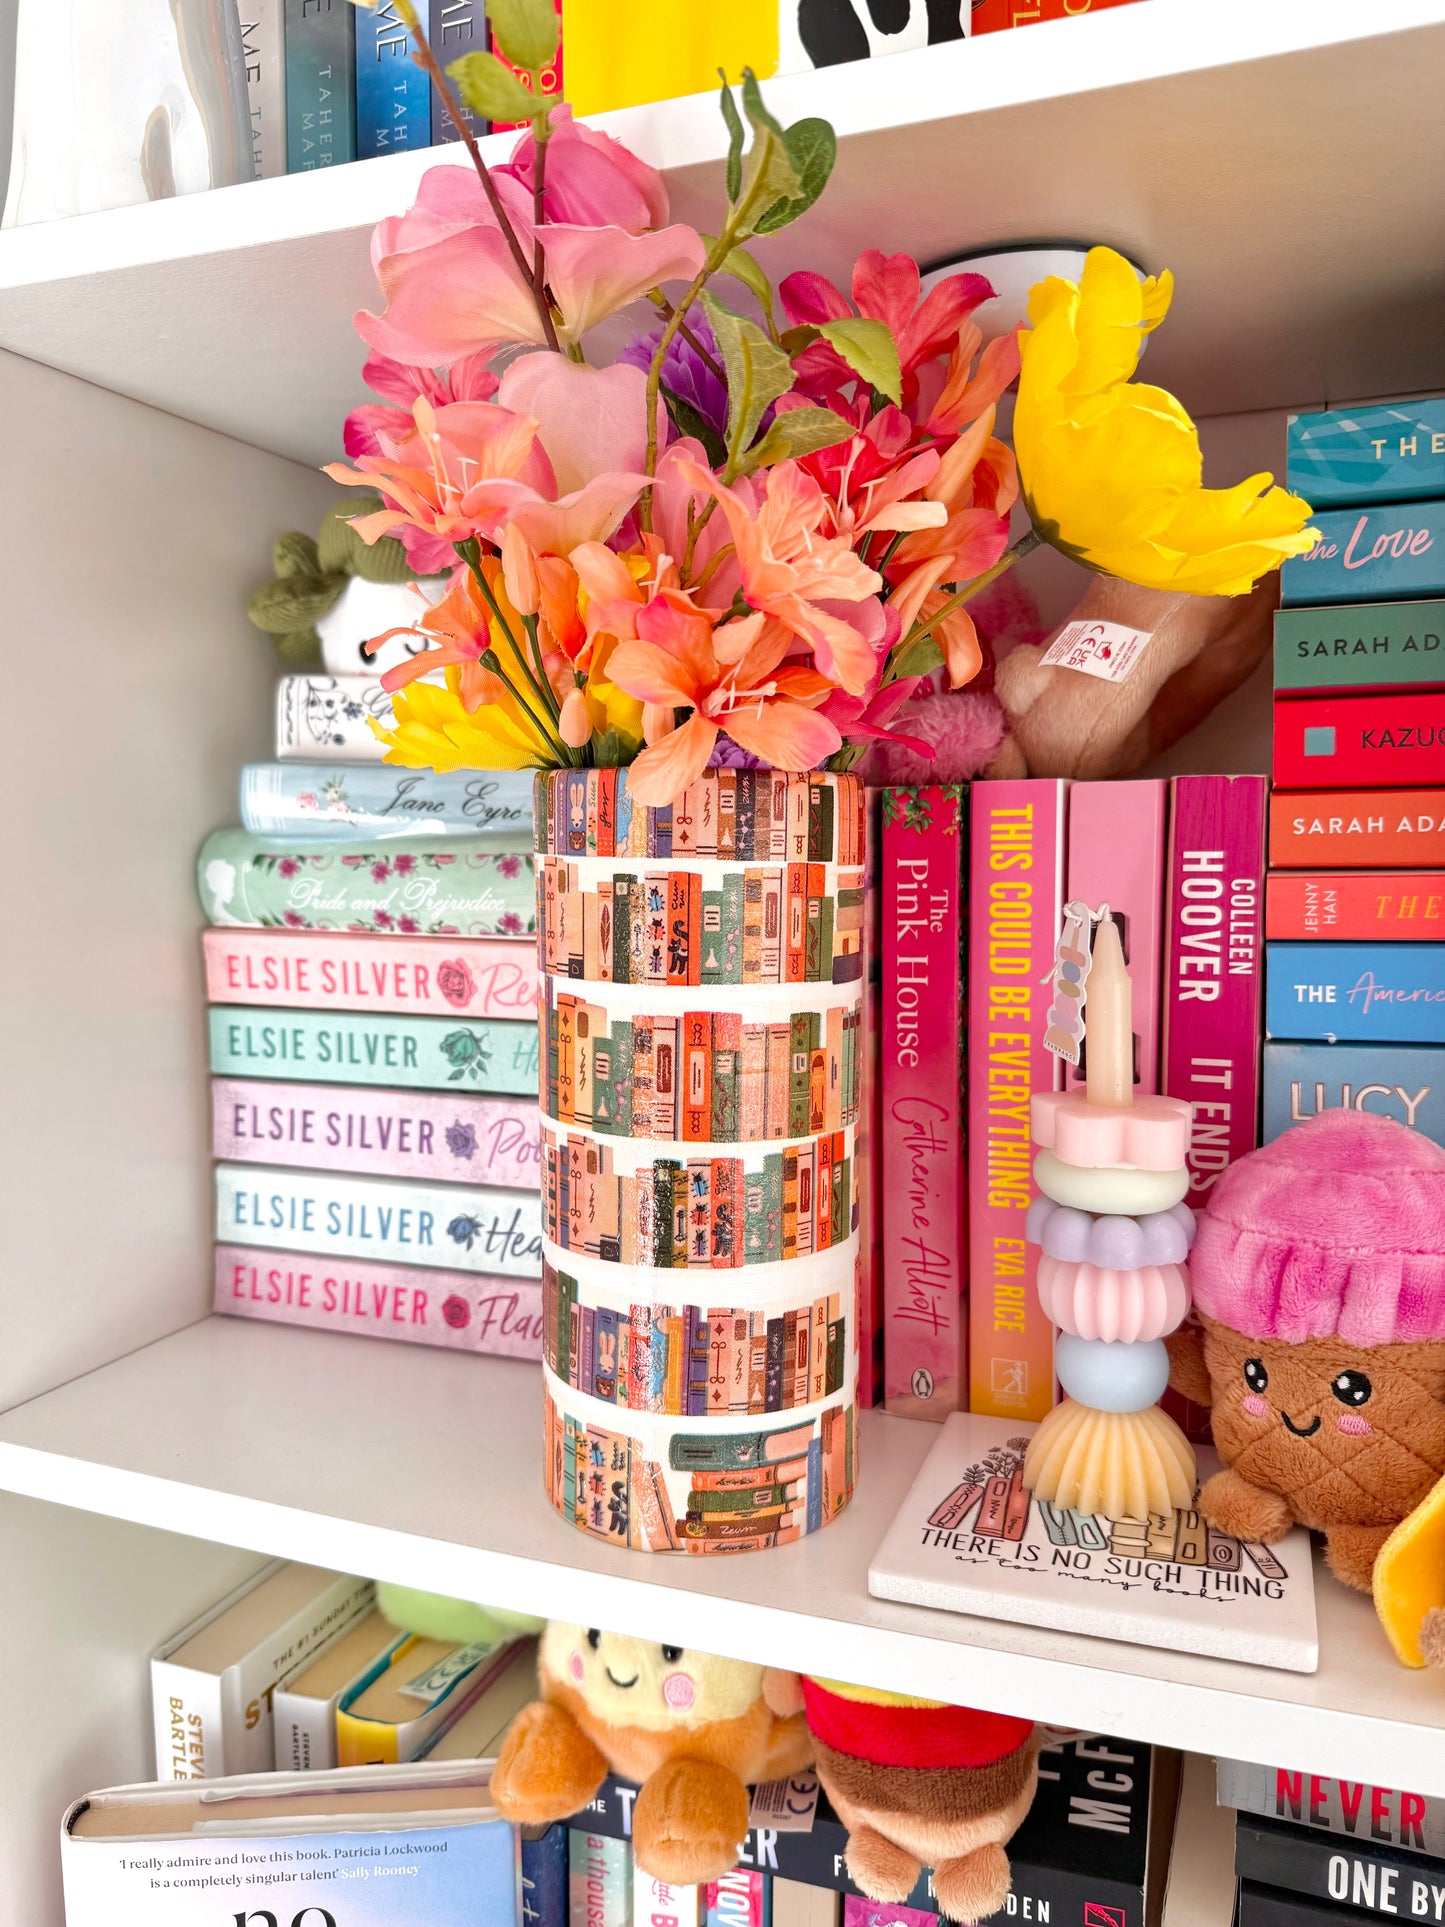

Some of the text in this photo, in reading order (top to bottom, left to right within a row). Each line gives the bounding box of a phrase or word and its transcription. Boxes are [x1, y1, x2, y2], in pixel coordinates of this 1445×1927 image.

[393, 80, 408, 154] TAH
[1371, 432, 1445, 461] THE
[1343, 515, 1434, 570] Love
[1297, 632, 1445, 659] SARAH AD
[378, 776, 523, 828] Jane Eyre
[1292, 816, 1385, 836] SARAH
[287, 876, 506, 920] Pride and Prejudice
[929, 889, 949, 933] The
[1304, 881, 1320, 933] JENNY
[1323, 890, 1338, 925] HAN
[1375, 895, 1443, 919] THE
[1178, 850, 1225, 1002] HOOVER
[1228, 878, 1256, 976] COLLEEN
[227, 954, 431, 999] ELSIE SILVER
[896, 857, 929, 1068] Pink House
[988, 803, 1033, 1210] THIS COULD BE EVERYTHING
[1294, 984, 1337, 1003] THE
[228, 1024, 418, 1068] ELSIE SILVER
[1190, 1057, 1233, 1090] IT
[233, 1102, 434, 1154] ELSIE SILVER
[1289, 1081, 1432, 1128] LUCY
[234, 1191, 435, 1245] ELSIE SILVER
[891, 1096, 952, 1336] Catherine Alliott
[232, 1265, 428, 1325] ELSIE SILVER
[993, 1236, 1026, 1334] EVA RICE
[921, 1527, 1286, 1599] THERE IS NO SUCH THING
[954, 1555, 1236, 1602] as too many books
[1276, 1767, 1427, 1850] NEVER
[129, 1857, 163, 1871] really
[166, 1856, 212, 1868] admire
[214, 1853, 238, 1866] and
[241, 1852, 267, 1864] love
[269, 1850, 293, 1862] this
[296, 1849, 331, 1861] book.
[334, 1846, 381, 1859] Patricia
[384, 1841, 448, 1856] Lockwood
[586, 1835, 604, 1849] a
[150, 1878, 161, 1889] is
[163, 1879, 170, 1888] a
[173, 1873, 243, 1889] completely
[245, 1870, 298, 1884] singular
[341, 1865, 371, 1880] Sally
[374, 1863, 420, 1877] Rooney
[1328, 1855, 1445, 1921] ONE BY
